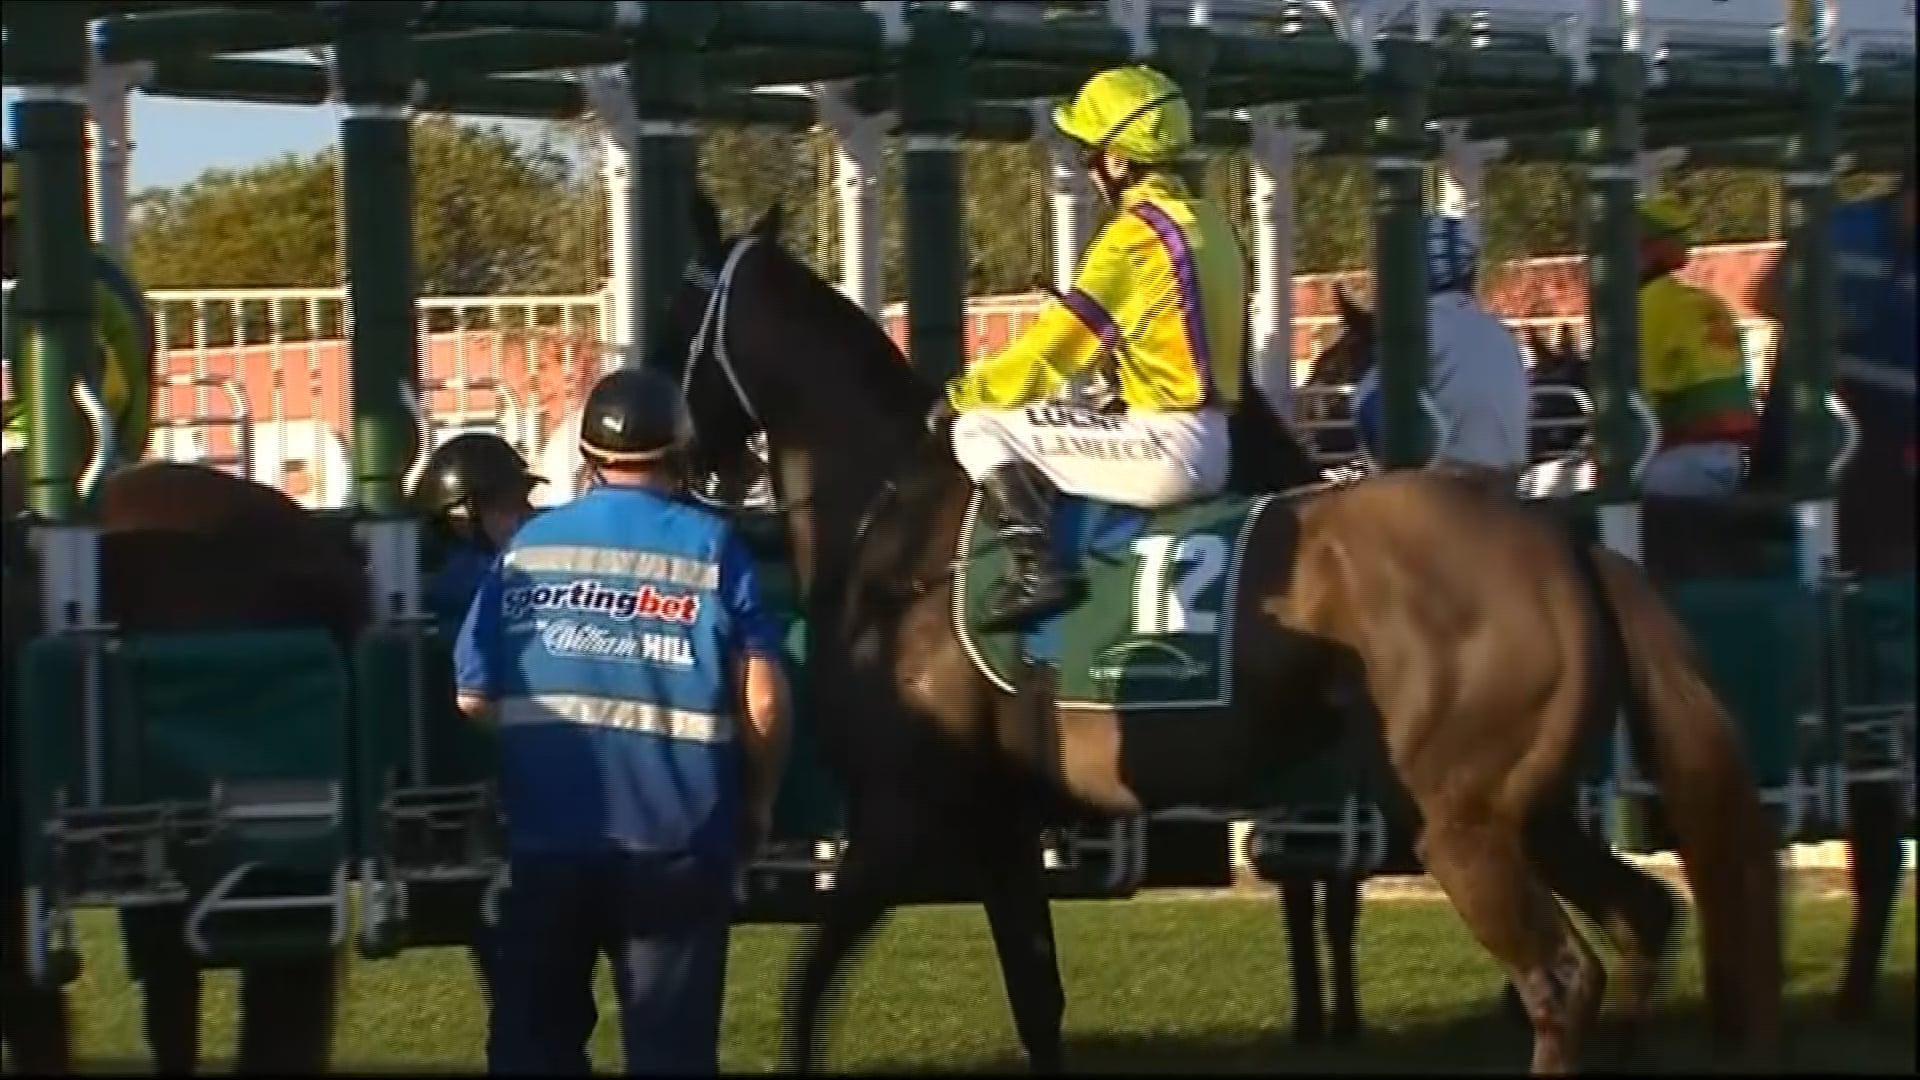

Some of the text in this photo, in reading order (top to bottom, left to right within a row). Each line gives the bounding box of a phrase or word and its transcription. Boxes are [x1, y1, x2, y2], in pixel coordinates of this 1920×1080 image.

[502, 580, 700, 624] sportingbet
[1131, 534, 1229, 634] 12
[541, 617, 638, 658] William
[641, 632, 695, 666] HILL
